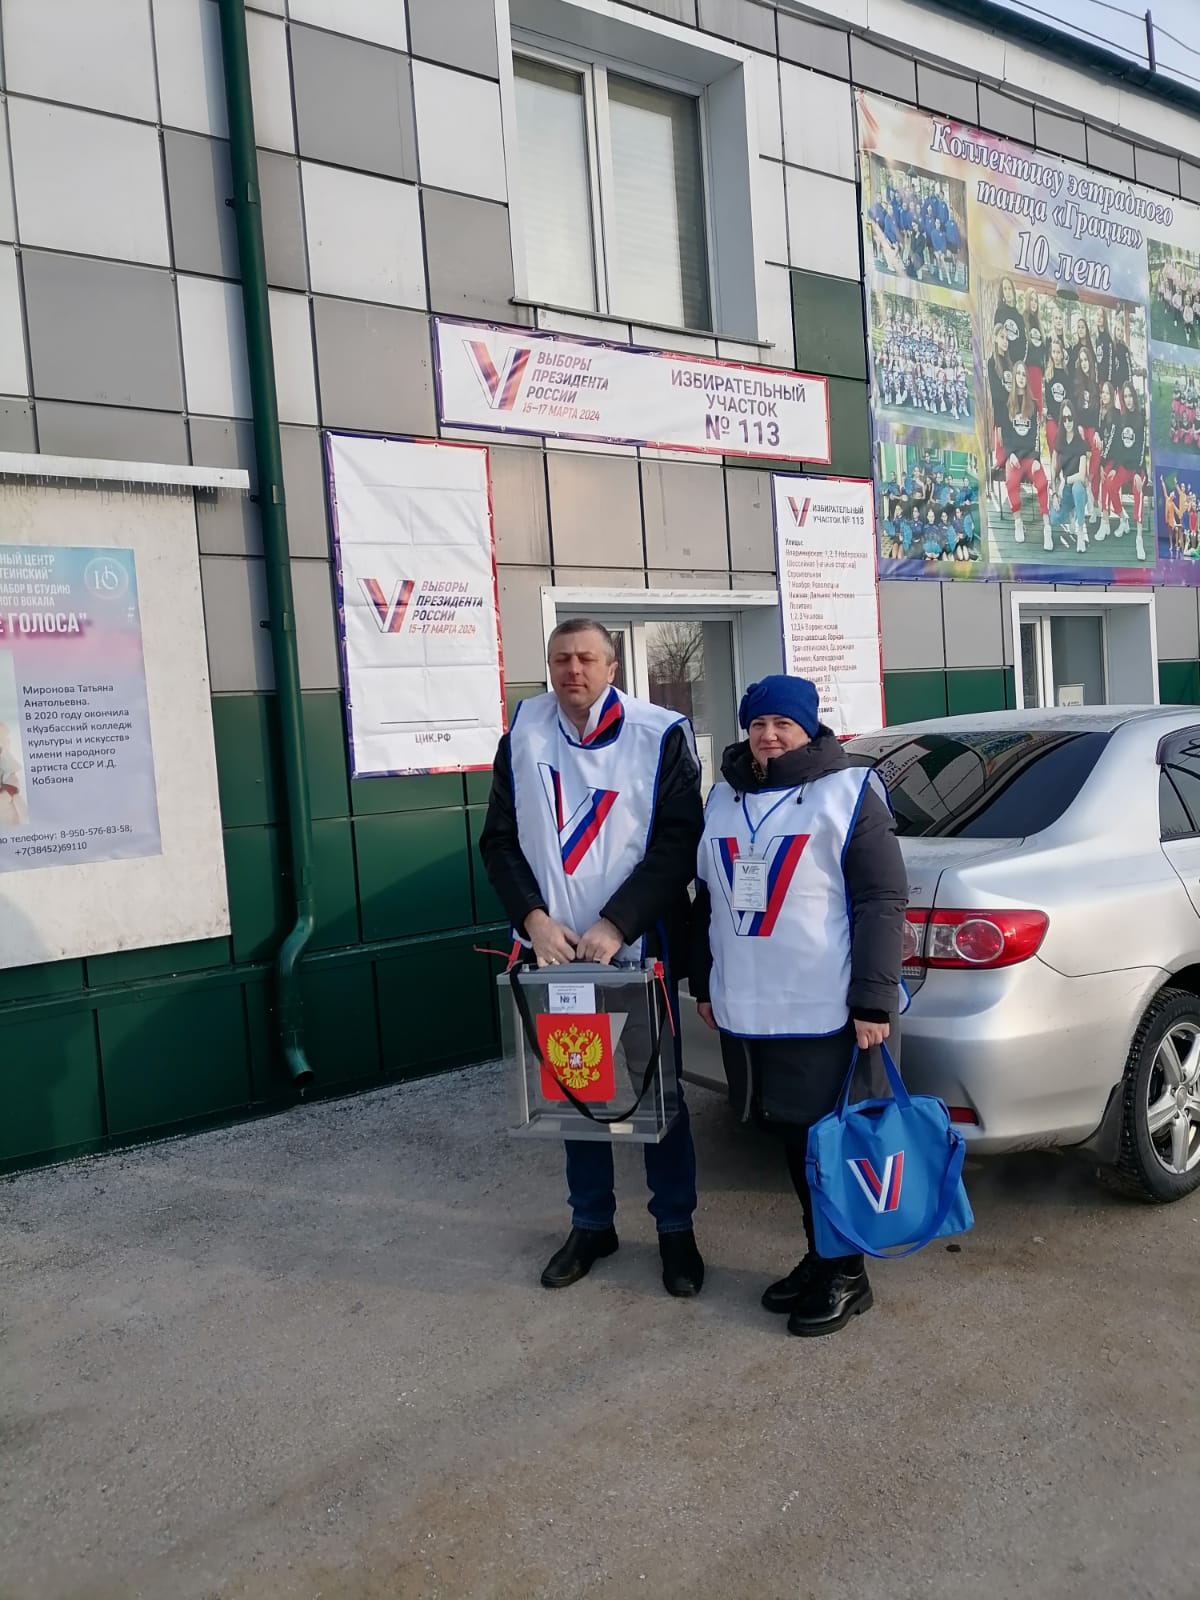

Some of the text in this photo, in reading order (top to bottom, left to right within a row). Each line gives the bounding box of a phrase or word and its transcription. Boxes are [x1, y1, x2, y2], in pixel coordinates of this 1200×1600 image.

[930, 120, 1173, 227] Коллективу эстрадного
[977, 181, 1143, 249] танца «Грация»
[1015, 231, 1111, 291] 10 лет
[537, 351, 592, 371] ВЫБОРЫ
[531, 369, 609, 390] ПРЕЗИДЕНТА
[671, 369, 806, 403] ИЗБИРАТЕЛЬНЫЙ
[526, 386, 577, 403] РОССИИ
[706, 393, 778, 418] УЧАСТОК
[549, 405, 577, 419] МАРТА
[579, 409, 600, 421] 2024
[705, 414, 780, 447] № 113
[812, 504, 864, 514] ИЗБИРАТЕЛЬНЫЙ
[814, 515, 864, 525] УЧАСТОК № 113
[24, 554, 55, 567] ЦЕНТР
[27, 583, 33, 594] В
[35, 583, 70, 595] СТУДИЮ
[421, 580, 469, 593] ВЫБОРЫ
[21, 596, 55, 607] ВОКАЛА
[416, 595, 483, 608] ПРЕЗИДЕНТА
[412, 610, 456, 621] РОССИИ
[431, 624, 458, 634] МАРТА
[459, 624, 476, 634] 2024
[22, 684, 114, 695] Миронова Татьяна
[24, 698, 90, 707] Анатольевна.
[25, 709, 129, 721] В 2020 году окончила
[27, 721, 132, 734] «Кузбасский колледж
[28, 738, 73, 747] культуры
[84, 735, 130, 744] искусств»
[415, 733, 451, 744] ЦИК.РФ
[29, 748, 116, 759] имени народного
[30, 764, 68, 773] артиста
[70, 761, 94, 770] СССР
[32, 776, 74, 785] Кобзона
[11, 832, 58, 843] телефону:
[15, 841, 88, 856] +7(38452)69110
